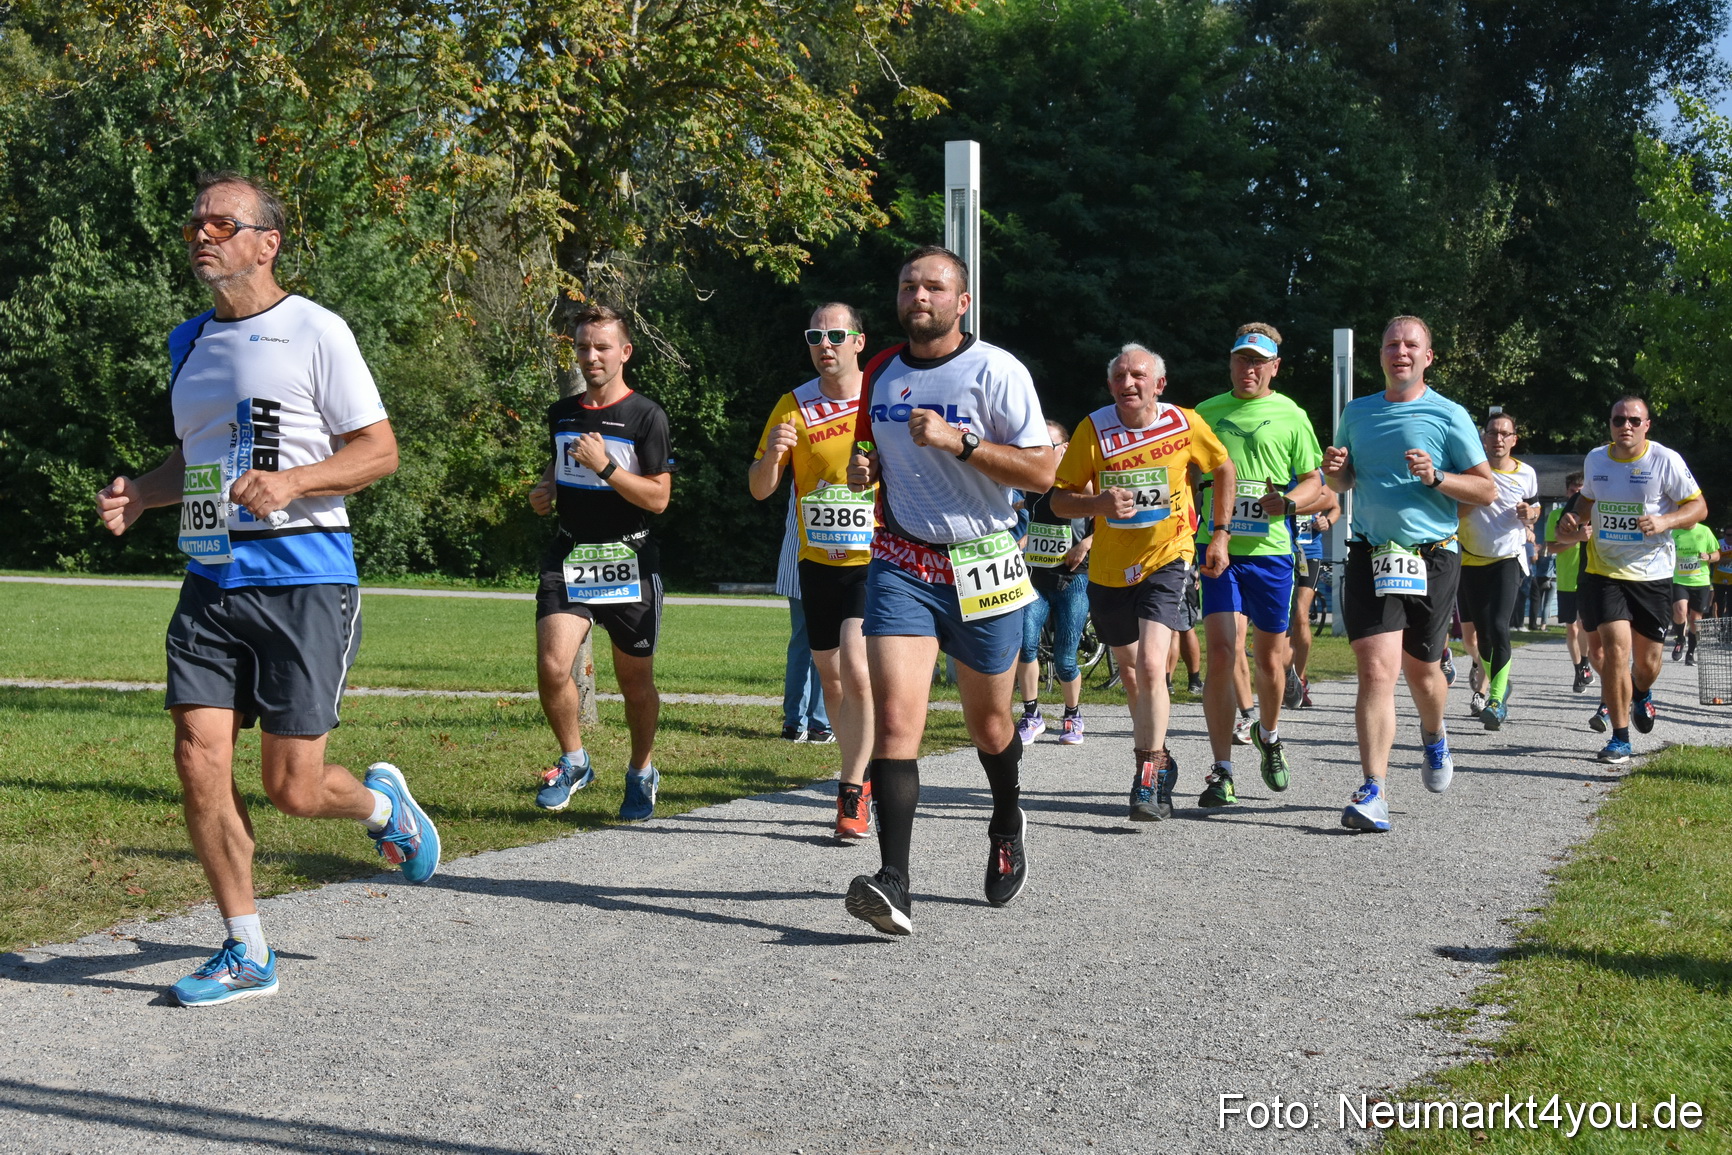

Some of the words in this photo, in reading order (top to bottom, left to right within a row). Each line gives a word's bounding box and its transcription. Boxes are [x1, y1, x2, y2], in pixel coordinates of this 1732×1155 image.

[808, 421, 852, 445] MAX
[1103, 470, 1163, 488] BOCK
[1600, 502, 1640, 514] BOCK
[809, 507, 867, 528] 2386
[1602, 515, 1638, 531] 2349
[811, 531, 867, 542] SEBASTIAN
[1030, 525, 1068, 538] BOCK
[1605, 532, 1635, 541] SAMUEL
[181, 539, 221, 553] MATTHIAS
[568, 545, 633, 562] BOCK
[1032, 538, 1068, 554] 1026
[1029, 554, 1067, 564] VERONIKA
[1373, 557, 1420, 577] 2418
[1679, 562, 1698, 570] 1407
[573, 563, 631, 584] 2168
[966, 553, 1025, 591] 1148
[1375, 579, 1413, 588] MARTIN
[577, 587, 630, 598] ANDREAS
[978, 587, 1024, 609] MARCEL
